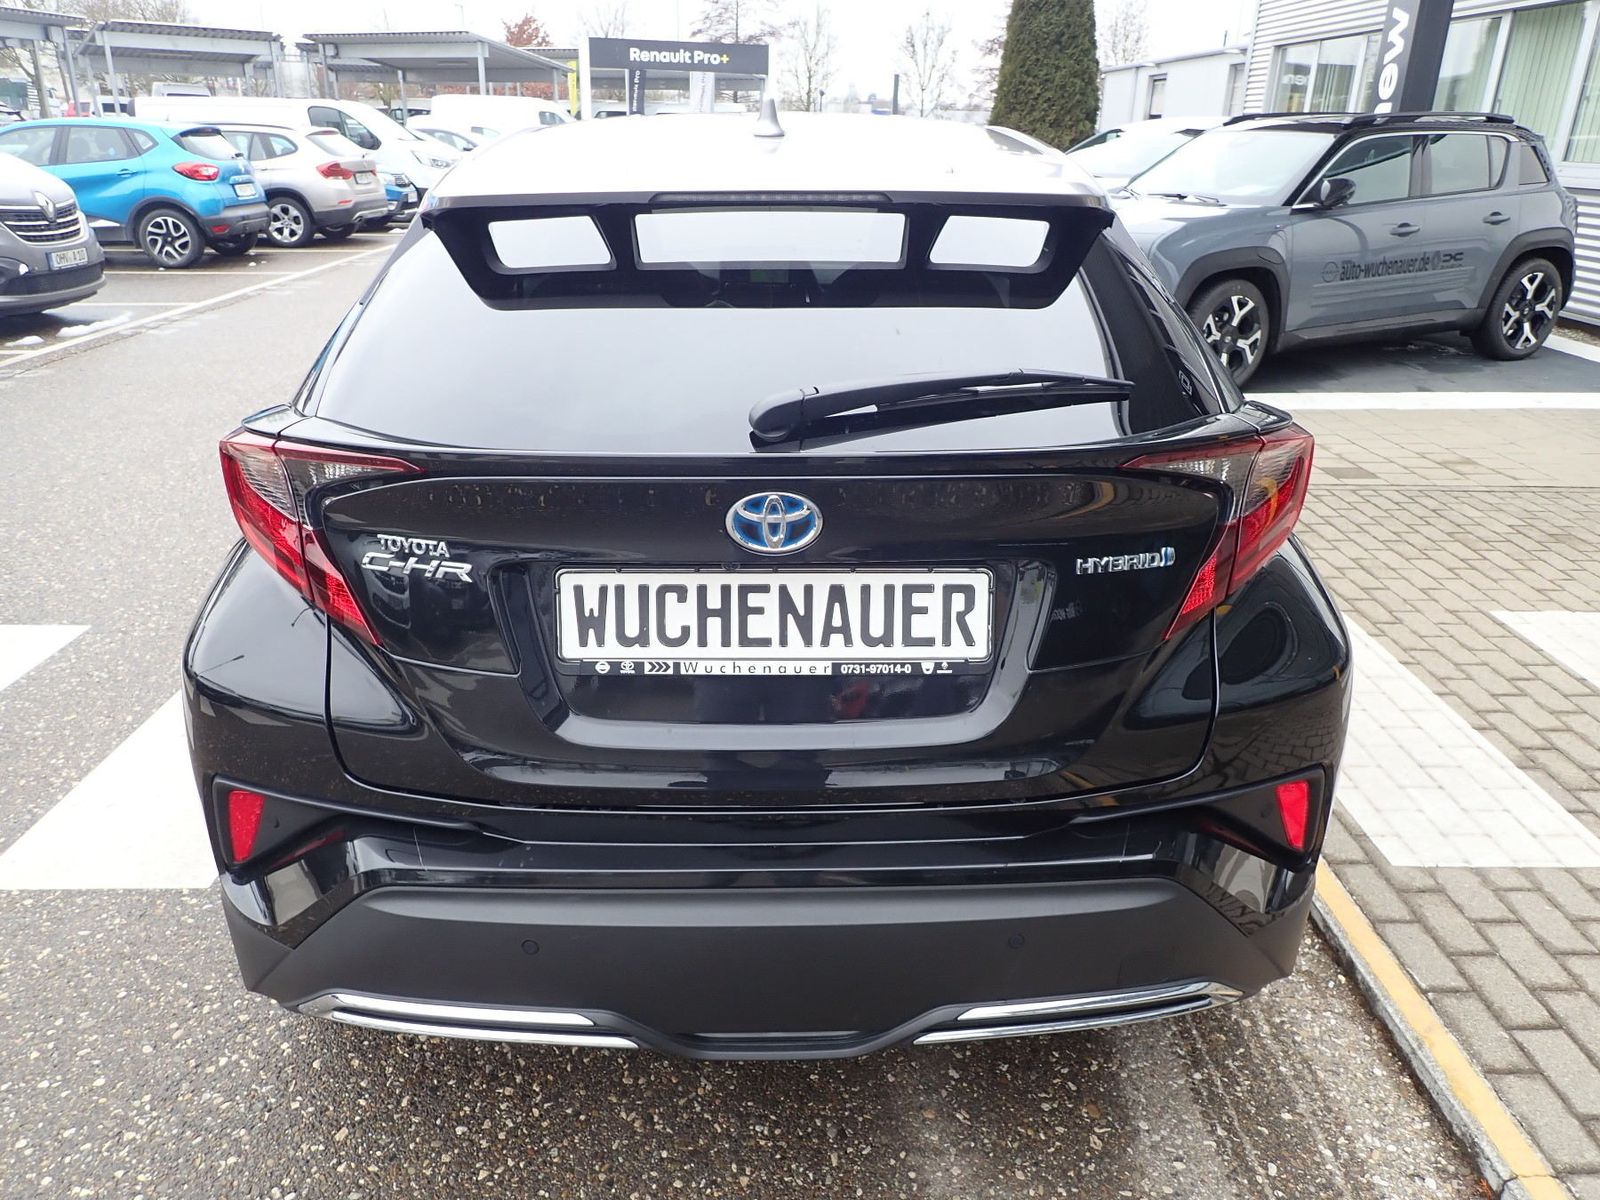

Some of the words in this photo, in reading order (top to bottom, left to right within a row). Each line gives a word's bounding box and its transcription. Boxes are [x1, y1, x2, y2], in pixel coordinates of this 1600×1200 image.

[629, 47, 692, 64] Renault
[694, 50, 730, 64] Pro+
[377, 534, 450, 558] TOYOTA
[361, 552, 473, 583] C-HR
[573, 583, 976, 648] WUCHENAUER
[683, 661, 830, 674] Wuchenauer
[840, 664, 912, 674] 0731-97014-0
